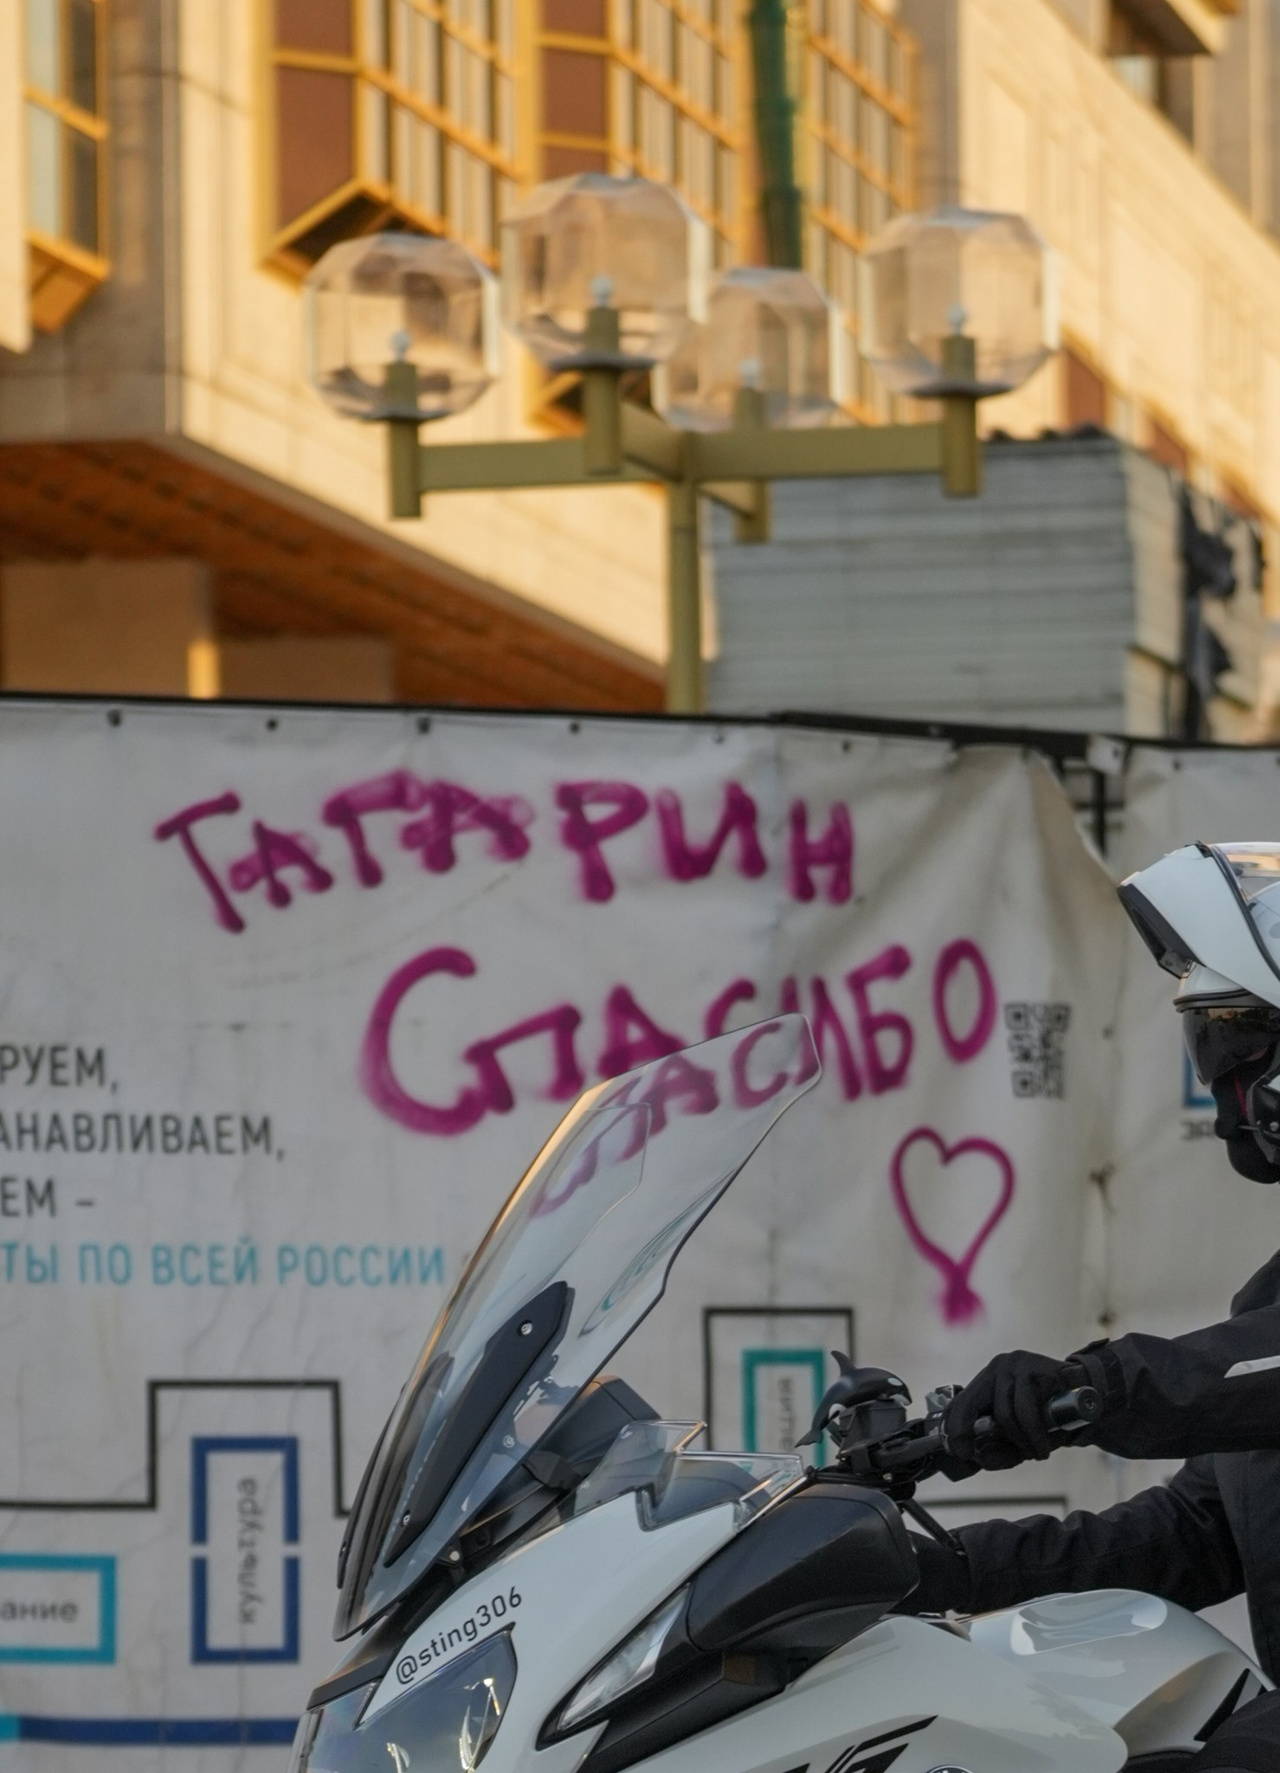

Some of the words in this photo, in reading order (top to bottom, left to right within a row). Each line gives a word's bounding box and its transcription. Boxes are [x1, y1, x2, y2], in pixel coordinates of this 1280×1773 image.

[79, 1242, 132, 1286] ПО
[151, 1235, 258, 1287] ВСЕЙ
[277, 1244, 445, 1288] РОССИИ
[236, 1477, 265, 1625] культура
[396, 1586, 523, 1685] @sting306
